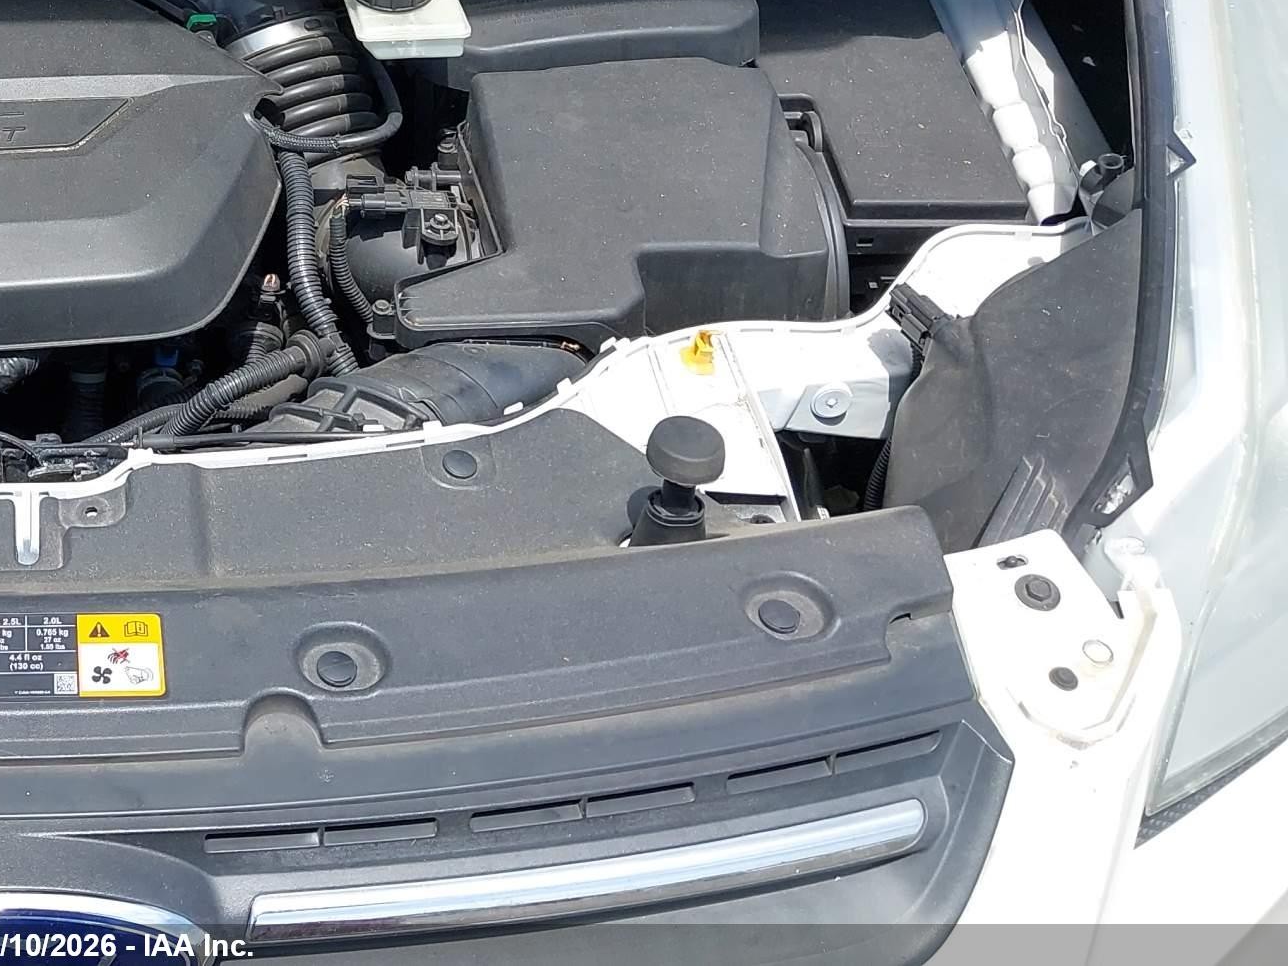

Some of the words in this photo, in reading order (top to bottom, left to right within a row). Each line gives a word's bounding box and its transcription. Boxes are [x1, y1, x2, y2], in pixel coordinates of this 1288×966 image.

[2, 617, 22, 625] 2.5L
[43, 616, 62, 625] 2.0L
[2, 629, 12, 638] kg
[58, 628, 69, 637] kg
[24, 653, 30, 661] fl
[9, 662, 28, 671] (130
[29, 662, 44, 671] cc)
